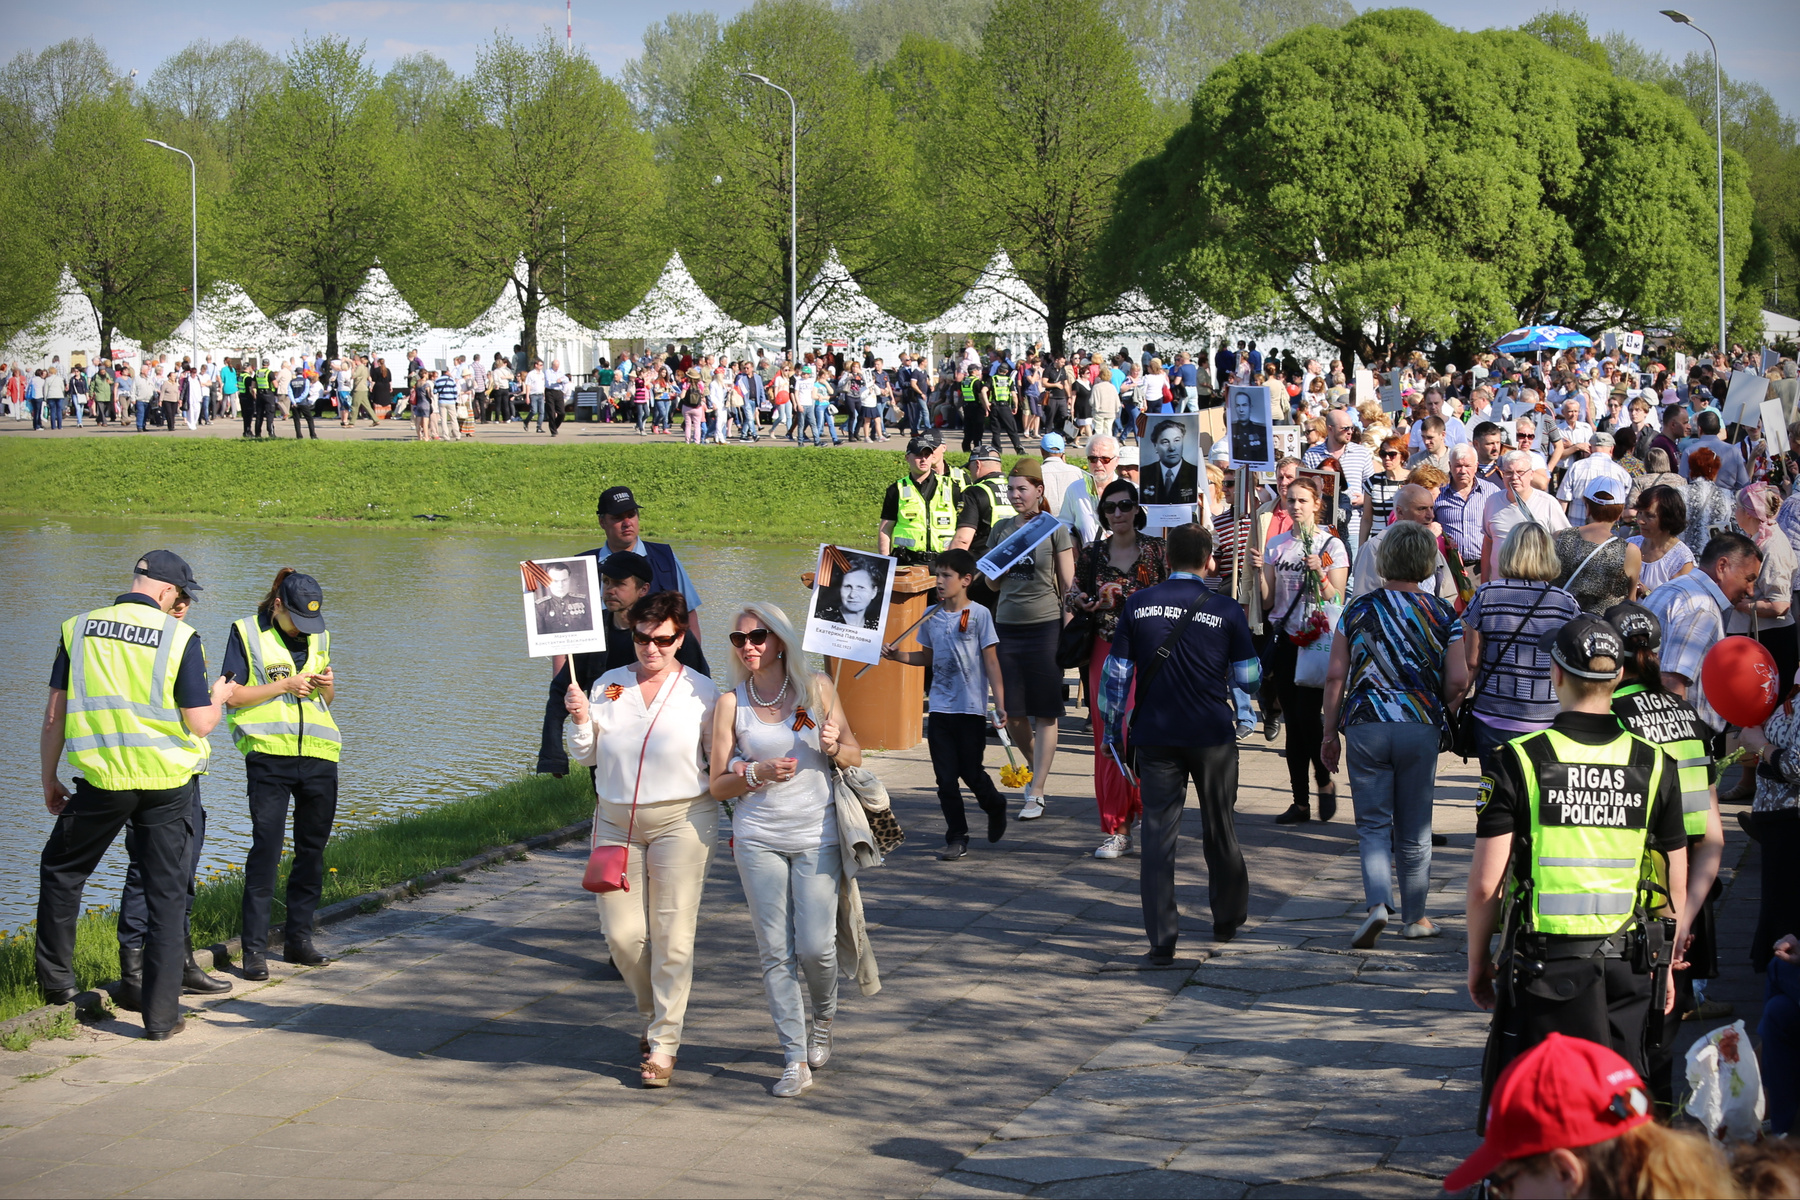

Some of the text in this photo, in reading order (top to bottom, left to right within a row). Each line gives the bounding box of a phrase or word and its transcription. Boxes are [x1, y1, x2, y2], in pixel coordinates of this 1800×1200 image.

[1163, 606, 1182, 620] ДЕДУ
[85, 620, 159, 646] POLICIJA
[815, 627, 844, 638] Екатерина
[844, 633, 872, 644] Павловна
[830, 624, 858, 635] Манухина
[1585, 641, 1619, 659] POLICIJA
[1632, 692, 1679, 712] RĪGAS
[1627, 708, 1697, 728] PAŠVALDĪBAS
[1641, 721, 1697, 743] POLICIJA
[1567, 765, 1626, 790] RĪGAS
[1547, 787, 1642, 808] PAŠVALDĪBAS
[1560, 804, 1627, 827] POLICIJA
